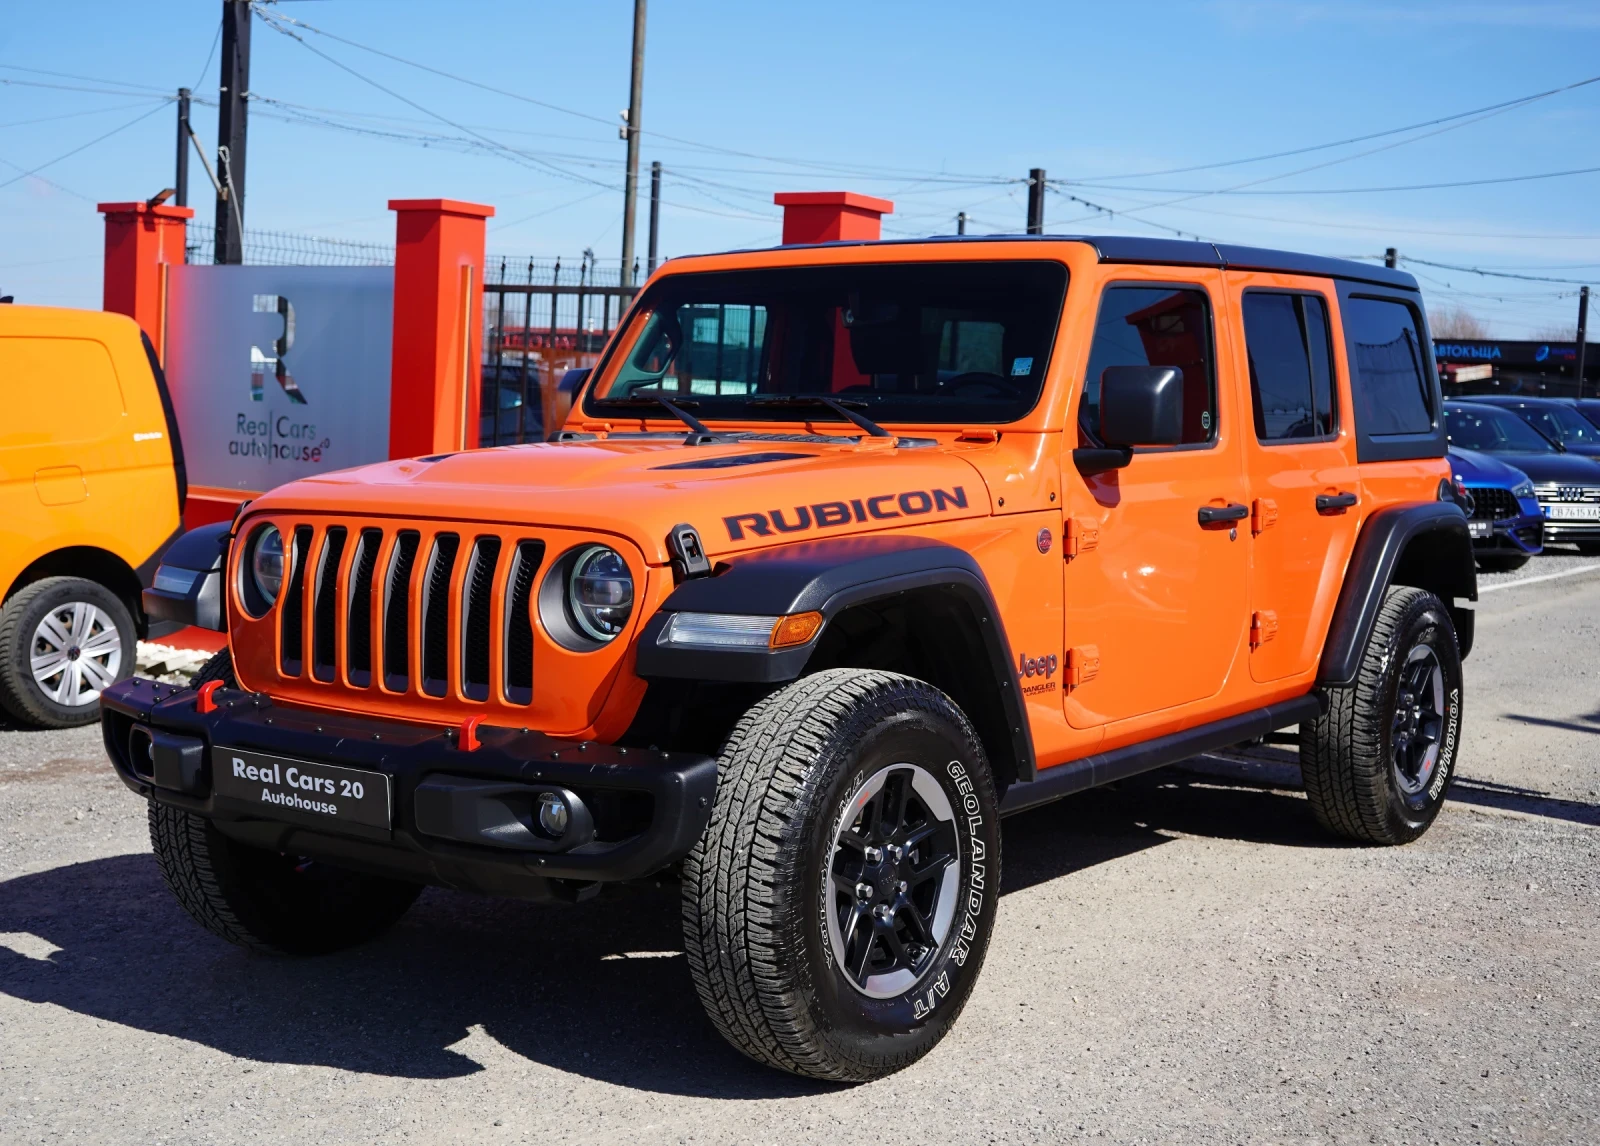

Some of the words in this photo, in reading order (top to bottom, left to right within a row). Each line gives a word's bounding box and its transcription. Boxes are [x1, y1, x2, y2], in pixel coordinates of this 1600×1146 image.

[236, 410, 273, 440] Real
[276, 415, 317, 441] Cars
[722, 485, 969, 542] RUBICON
[1017, 652, 1058, 680] Jeep
[1022, 682, 1056, 693] RANGLER
[1428, 688, 1459, 801] YOKOHAMA
[232, 757, 281, 785] Real
[285, 767, 336, 795] Cars
[339, 779, 365, 799] 20
[261, 788, 338, 815] Autohouse
[947, 759, 987, 967] GEOLANDAR
[913, 970, 951, 1021] A/T
